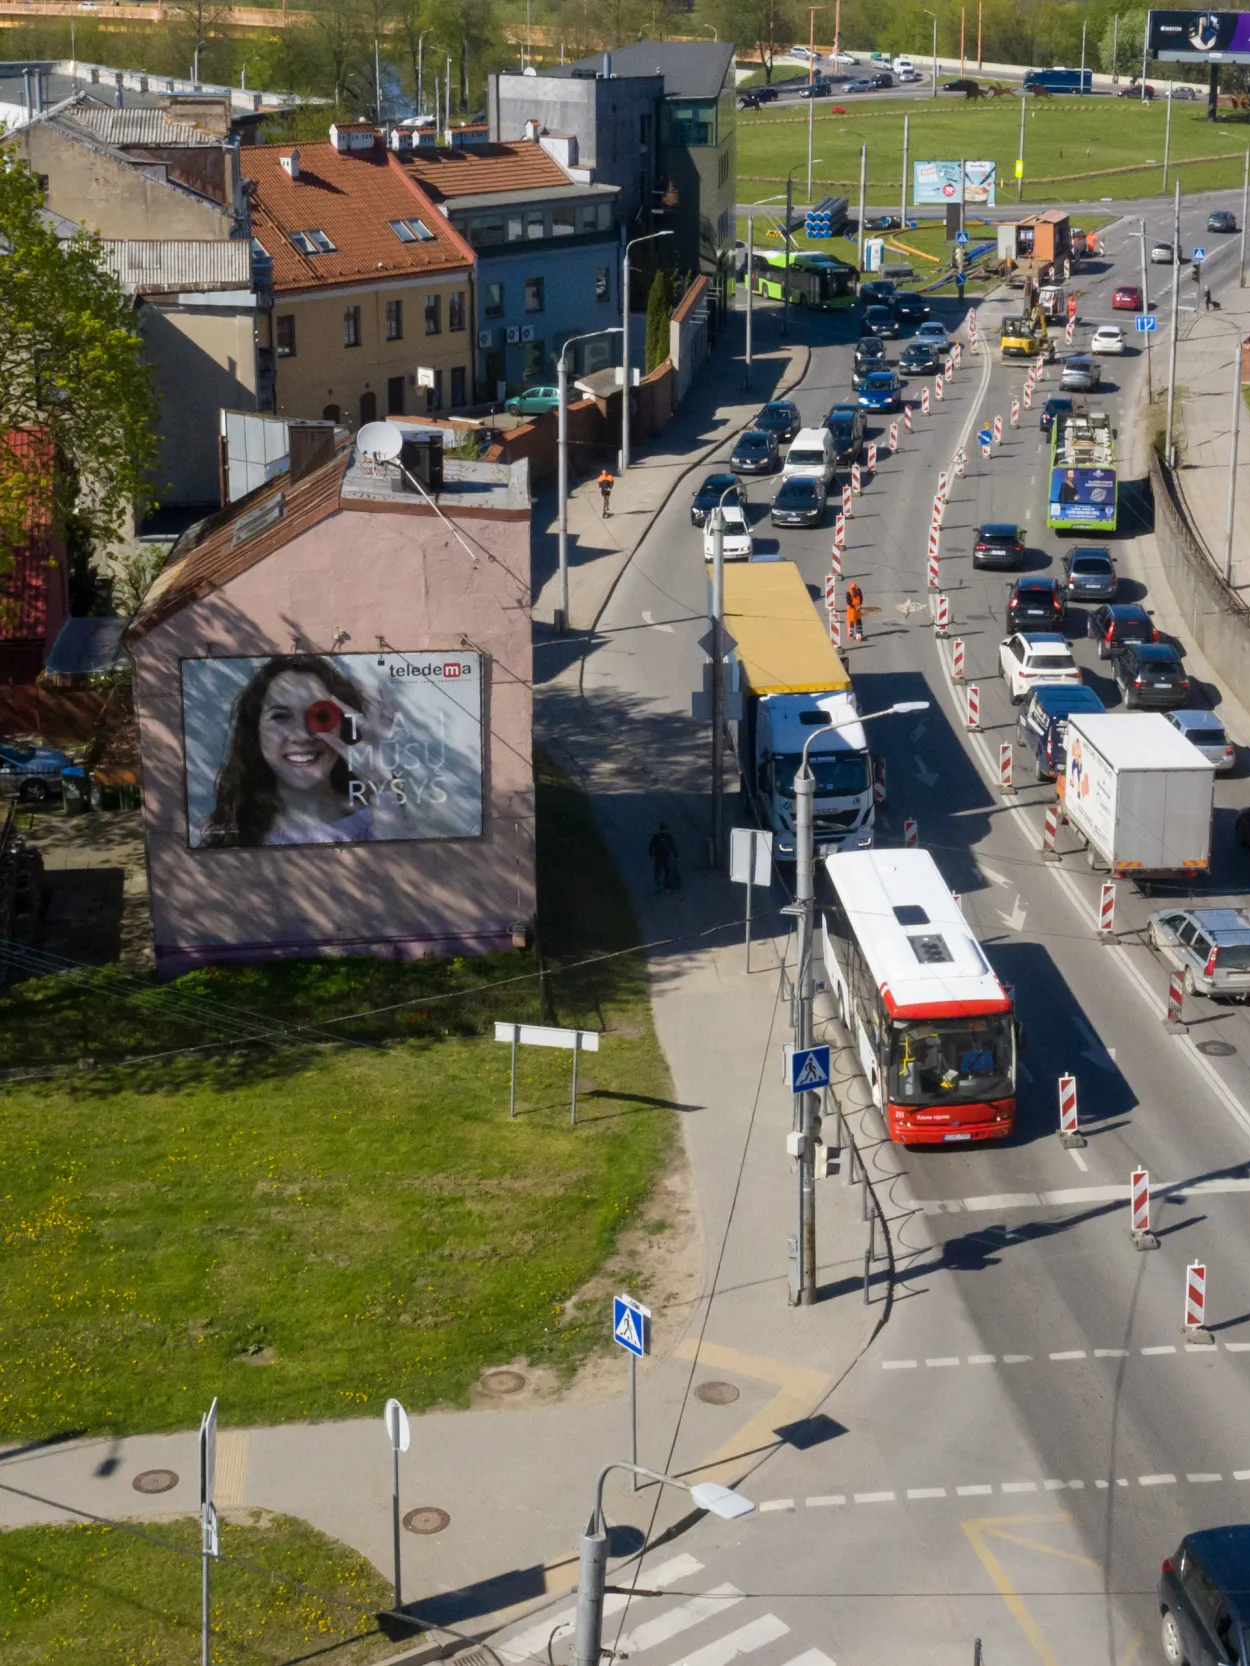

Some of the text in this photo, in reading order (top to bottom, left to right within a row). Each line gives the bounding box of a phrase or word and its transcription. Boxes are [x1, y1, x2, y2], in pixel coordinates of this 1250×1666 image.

[389, 663, 472, 678] teledema
[347, 740, 446, 774] MŪSŲ
[348, 770, 448, 807] RYŠYS
